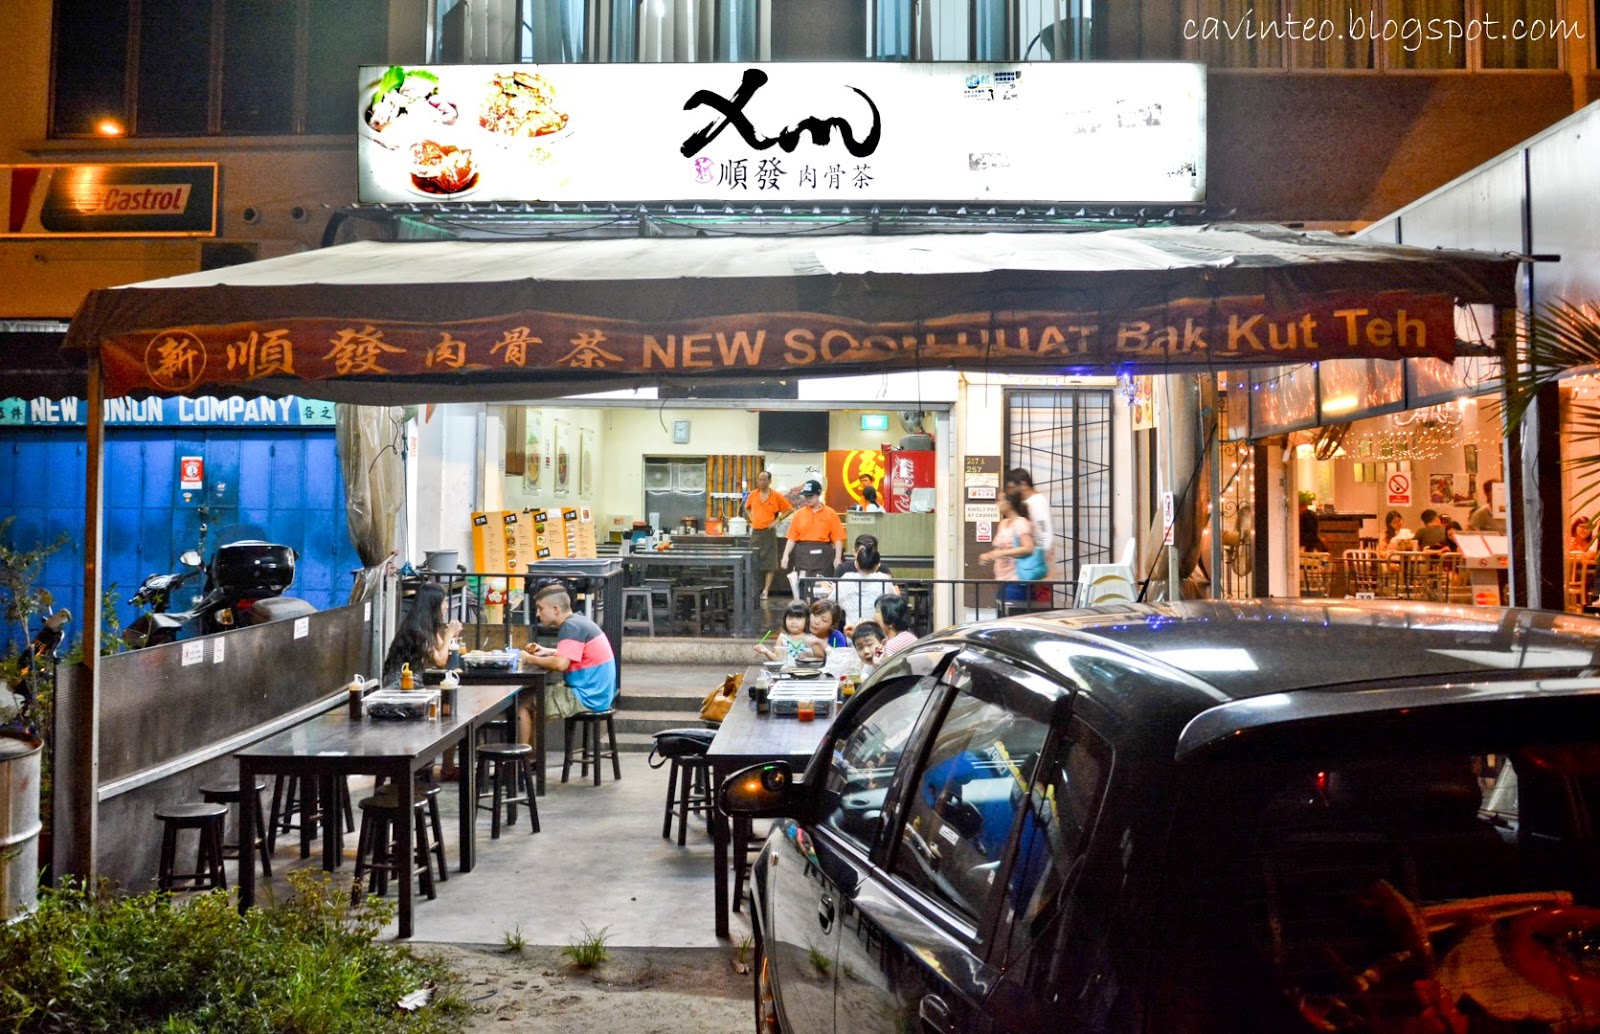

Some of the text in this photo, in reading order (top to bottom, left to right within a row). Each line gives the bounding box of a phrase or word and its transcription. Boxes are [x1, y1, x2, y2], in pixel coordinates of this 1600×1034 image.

[717, 157, 788, 191] 順發
[799, 163, 875, 191] 肉骨茶
[104, 188, 183, 211] Castrol
[642, 329, 767, 369] NEW
[1117, 318, 1208, 352] Bak
[1228, 313, 1319, 351] Kut
[1333, 308, 1427, 348] Teh
[31, 396, 78, 421] NEW
[178, 395, 296, 422] COMPANY
